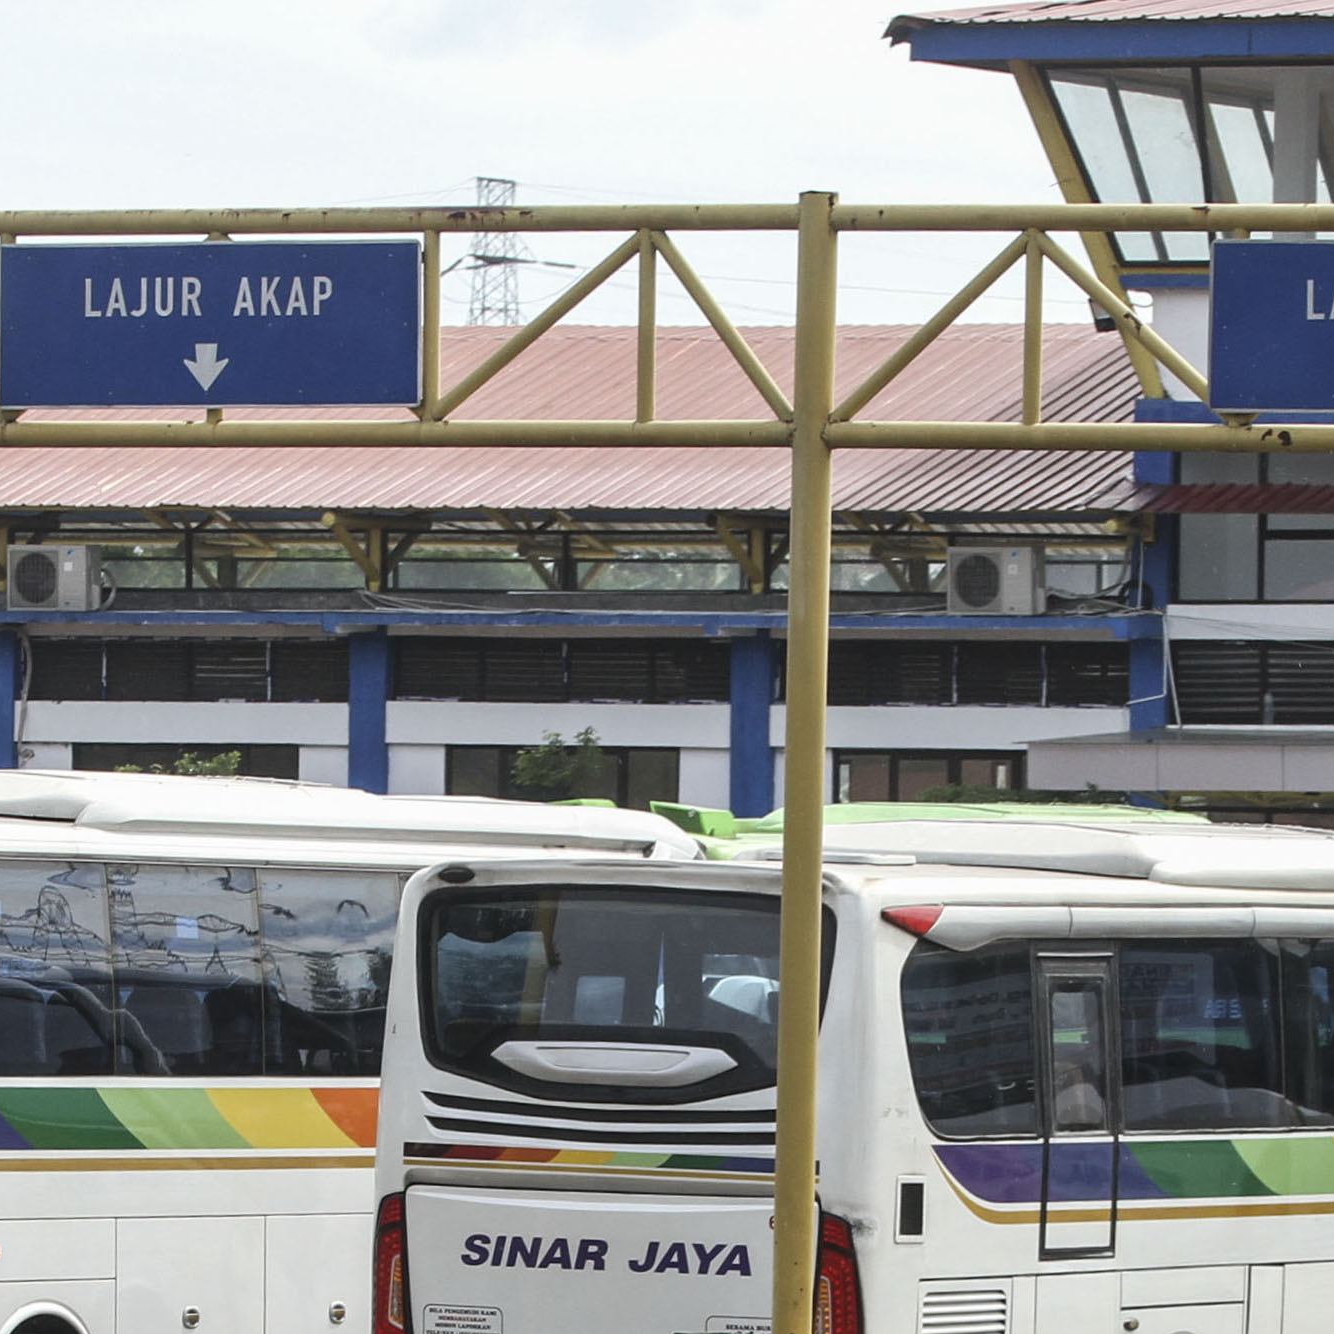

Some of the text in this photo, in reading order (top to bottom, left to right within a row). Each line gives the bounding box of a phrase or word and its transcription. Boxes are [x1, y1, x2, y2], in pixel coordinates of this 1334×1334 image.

[84, 275, 333, 317] LAJUR AKAP
[461, 1234, 751, 1277] SINAR JAYA
